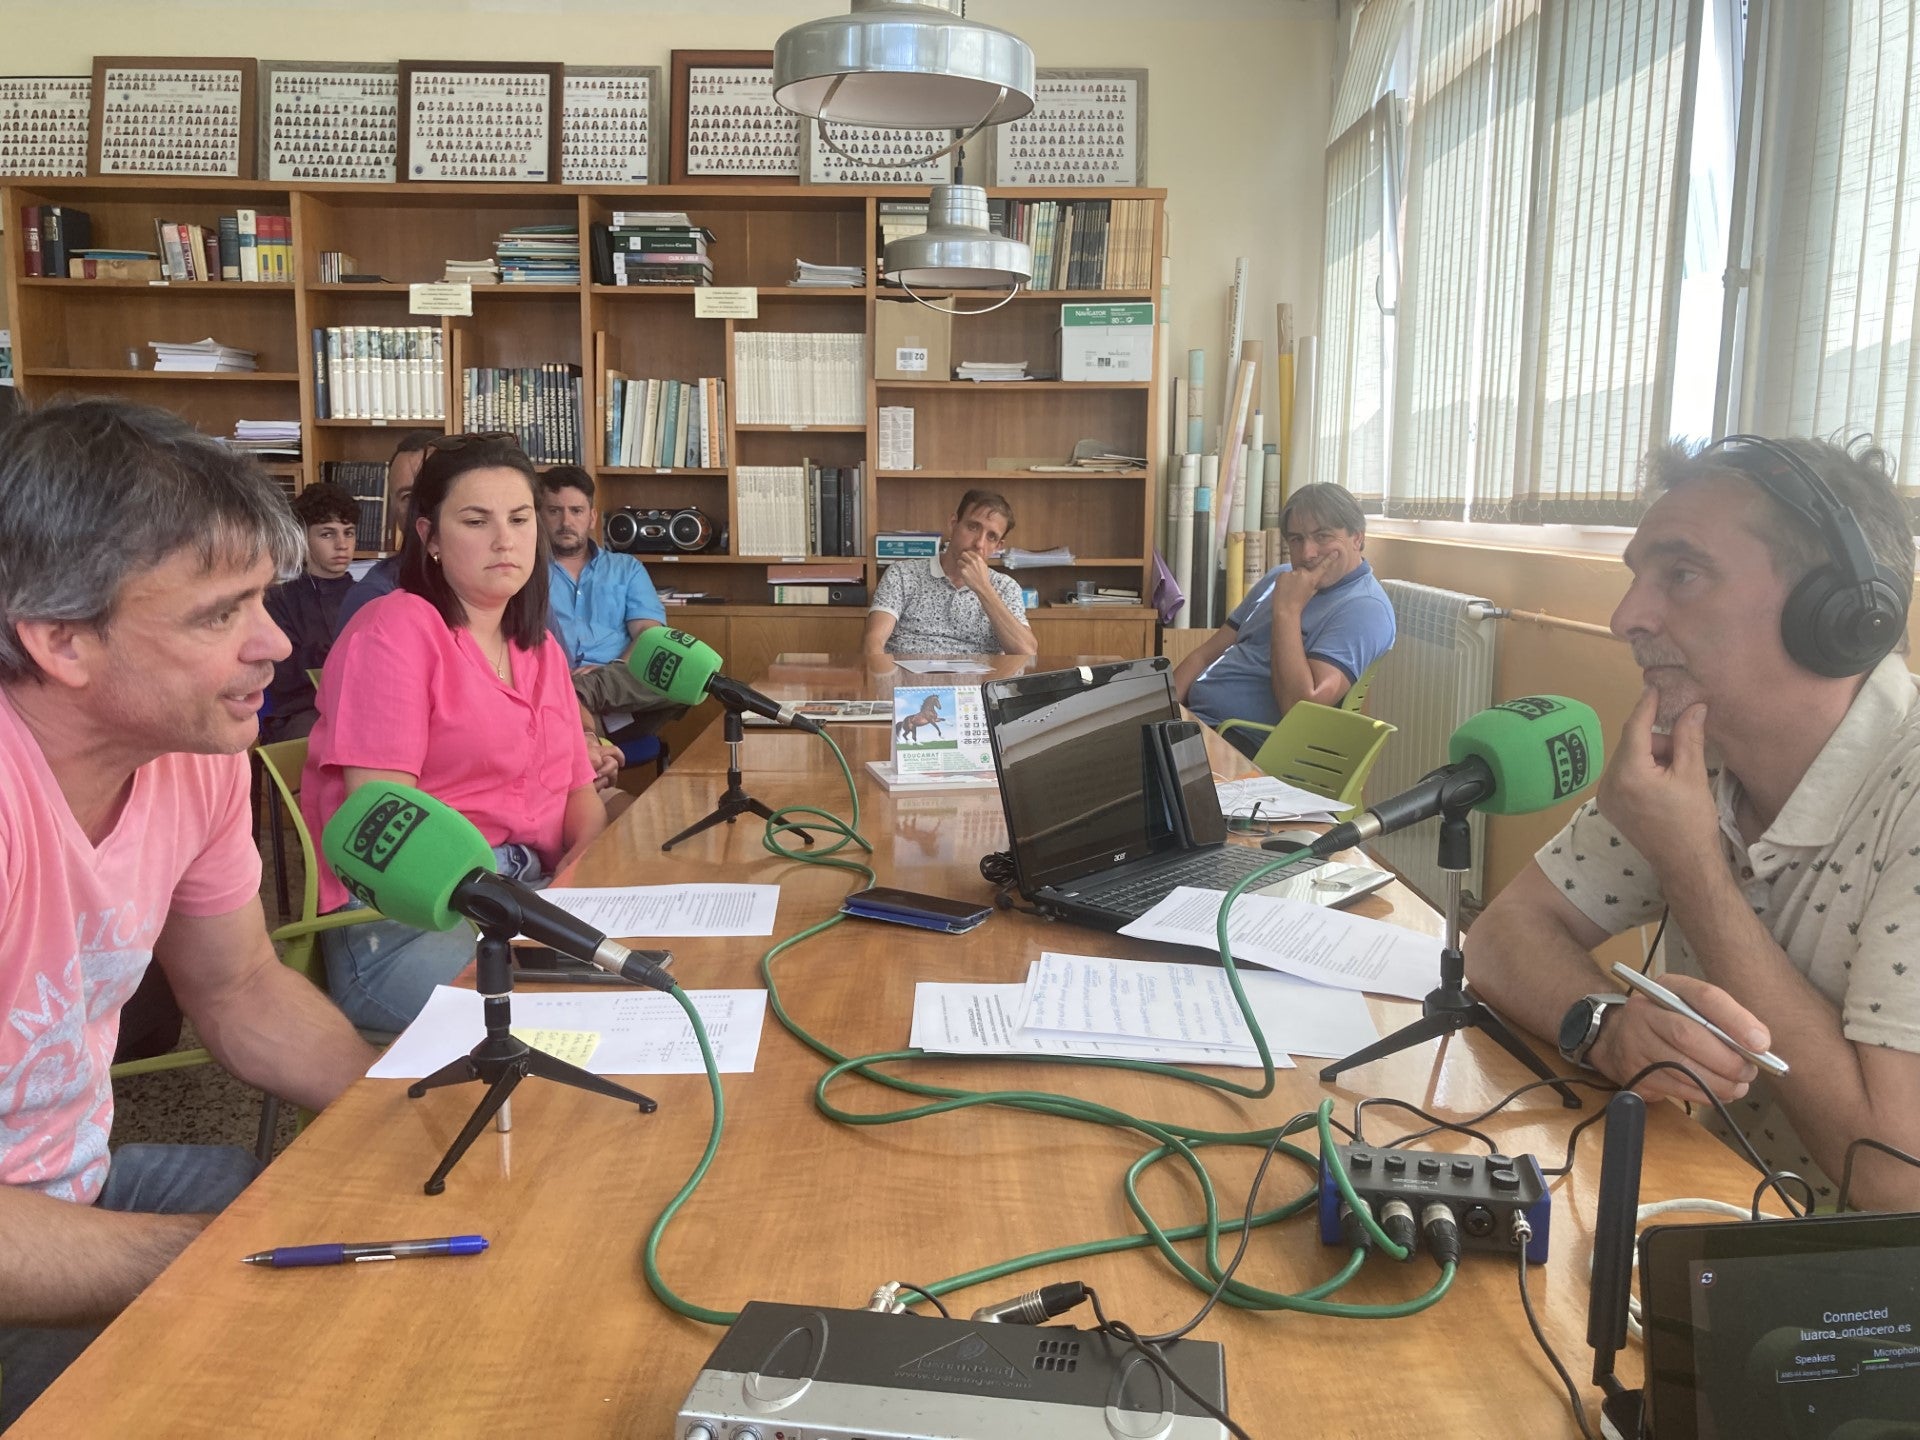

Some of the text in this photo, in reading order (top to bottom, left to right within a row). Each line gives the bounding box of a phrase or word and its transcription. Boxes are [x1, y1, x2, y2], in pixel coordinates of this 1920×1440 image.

[660, 658, 676, 684] CERO
[1556, 747, 1570, 788] CERO
[1571, 738, 1584, 784] ONDA
[357, 803, 397, 847] ONDA
[375, 811, 414, 855] CERO
[1114, 852, 1127, 862] acer
[1823, 1307, 1888, 1324] Connected
[1801, 1323, 1912, 1341] luarca_ondacero.es
[1795, 1354, 1836, 1366] Speakers
